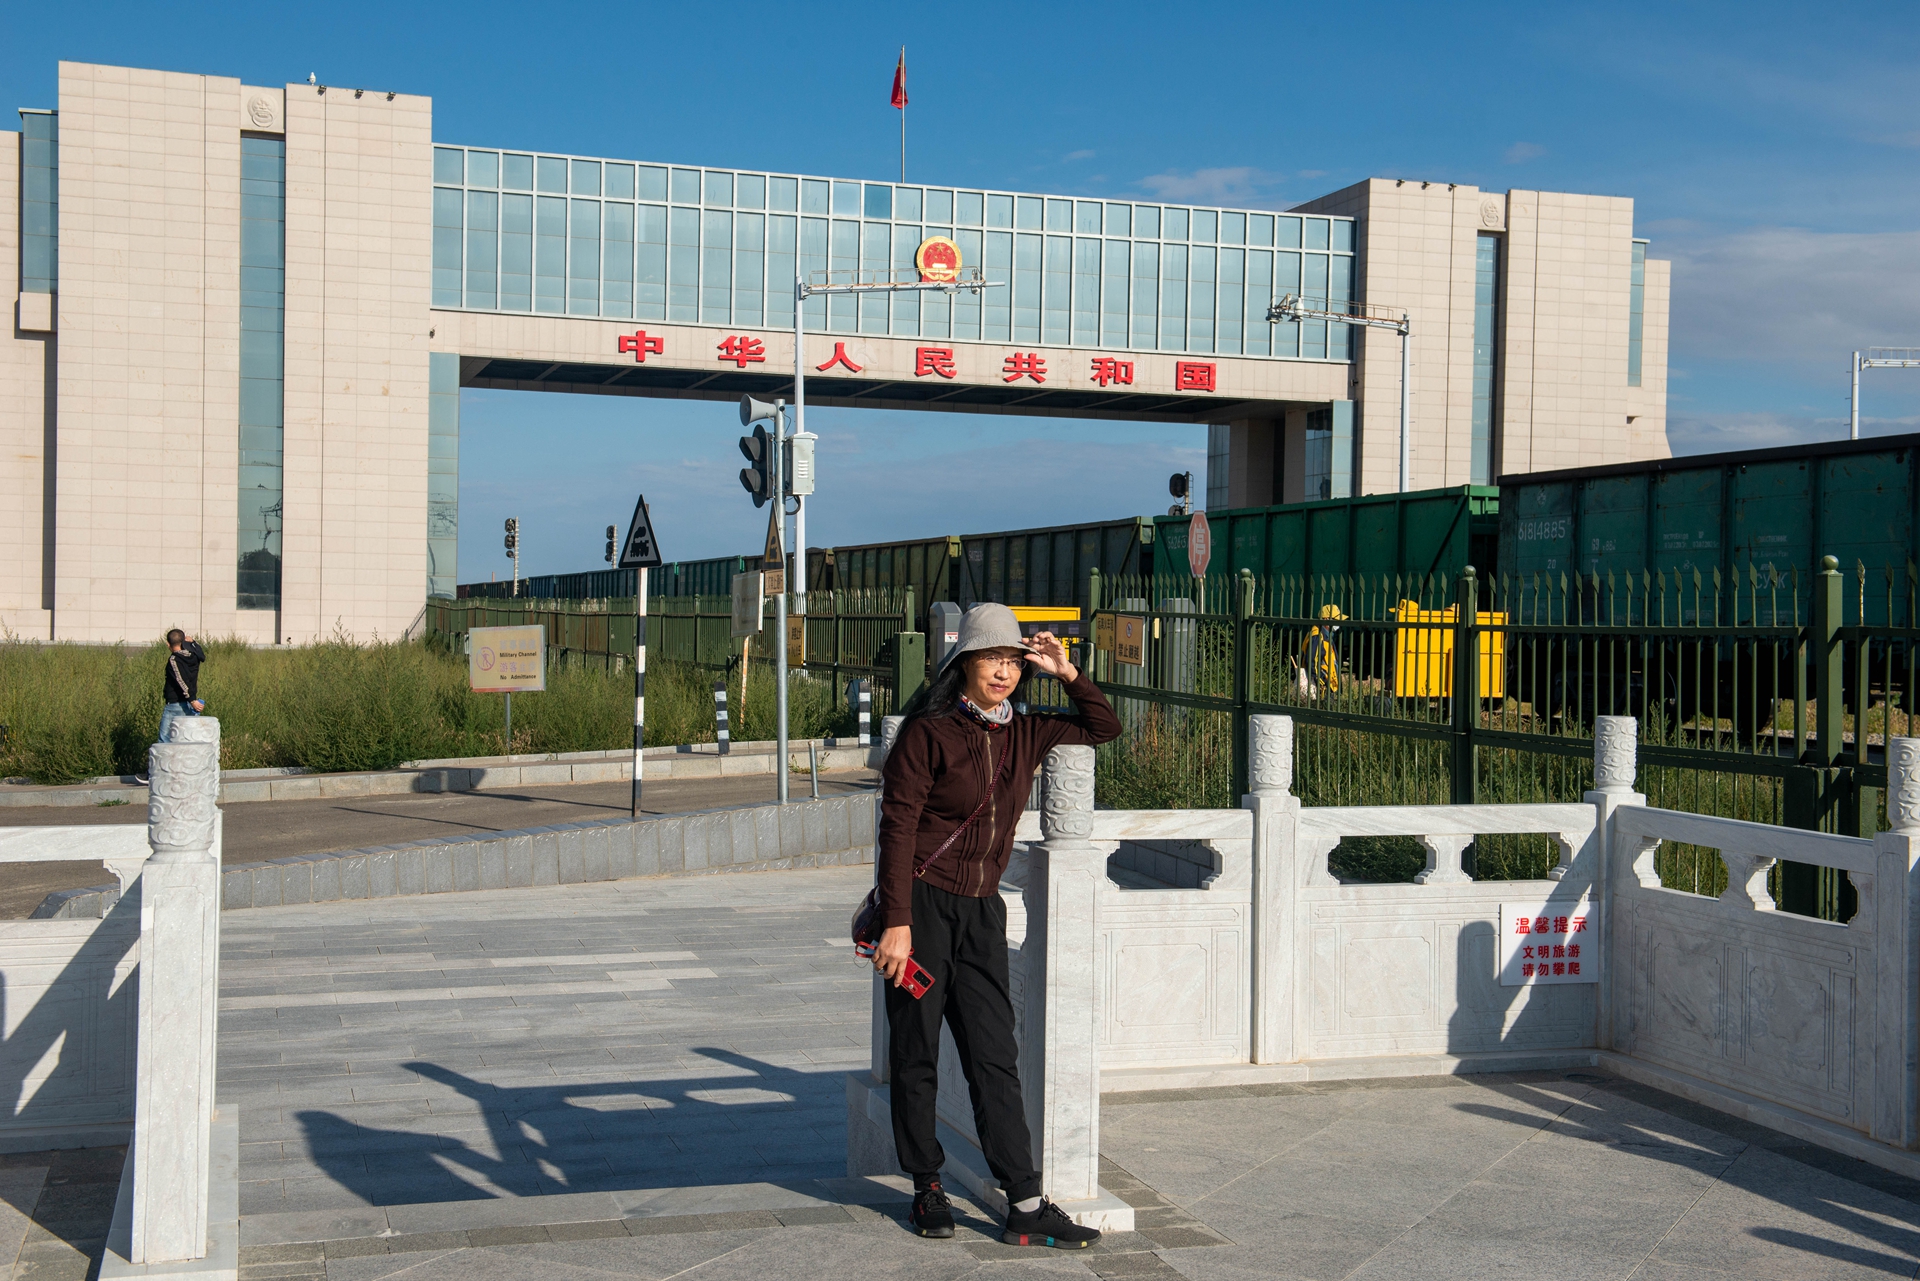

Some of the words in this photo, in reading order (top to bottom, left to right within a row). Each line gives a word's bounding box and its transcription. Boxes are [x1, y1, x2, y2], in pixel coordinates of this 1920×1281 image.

[618, 330, 1217, 393] 中华人民共和国
[1518, 520, 1566, 541] 61814885
[1191, 522, 1206, 566] 停
[1547, 559, 1557, 569] 20
[1756, 572, 1788, 589] СУК
[1515, 917, 1587, 934] 温馨提示
[1522, 945, 1580, 959] 文明旅游
[1522, 962, 1581, 977] 请勿攀爬
